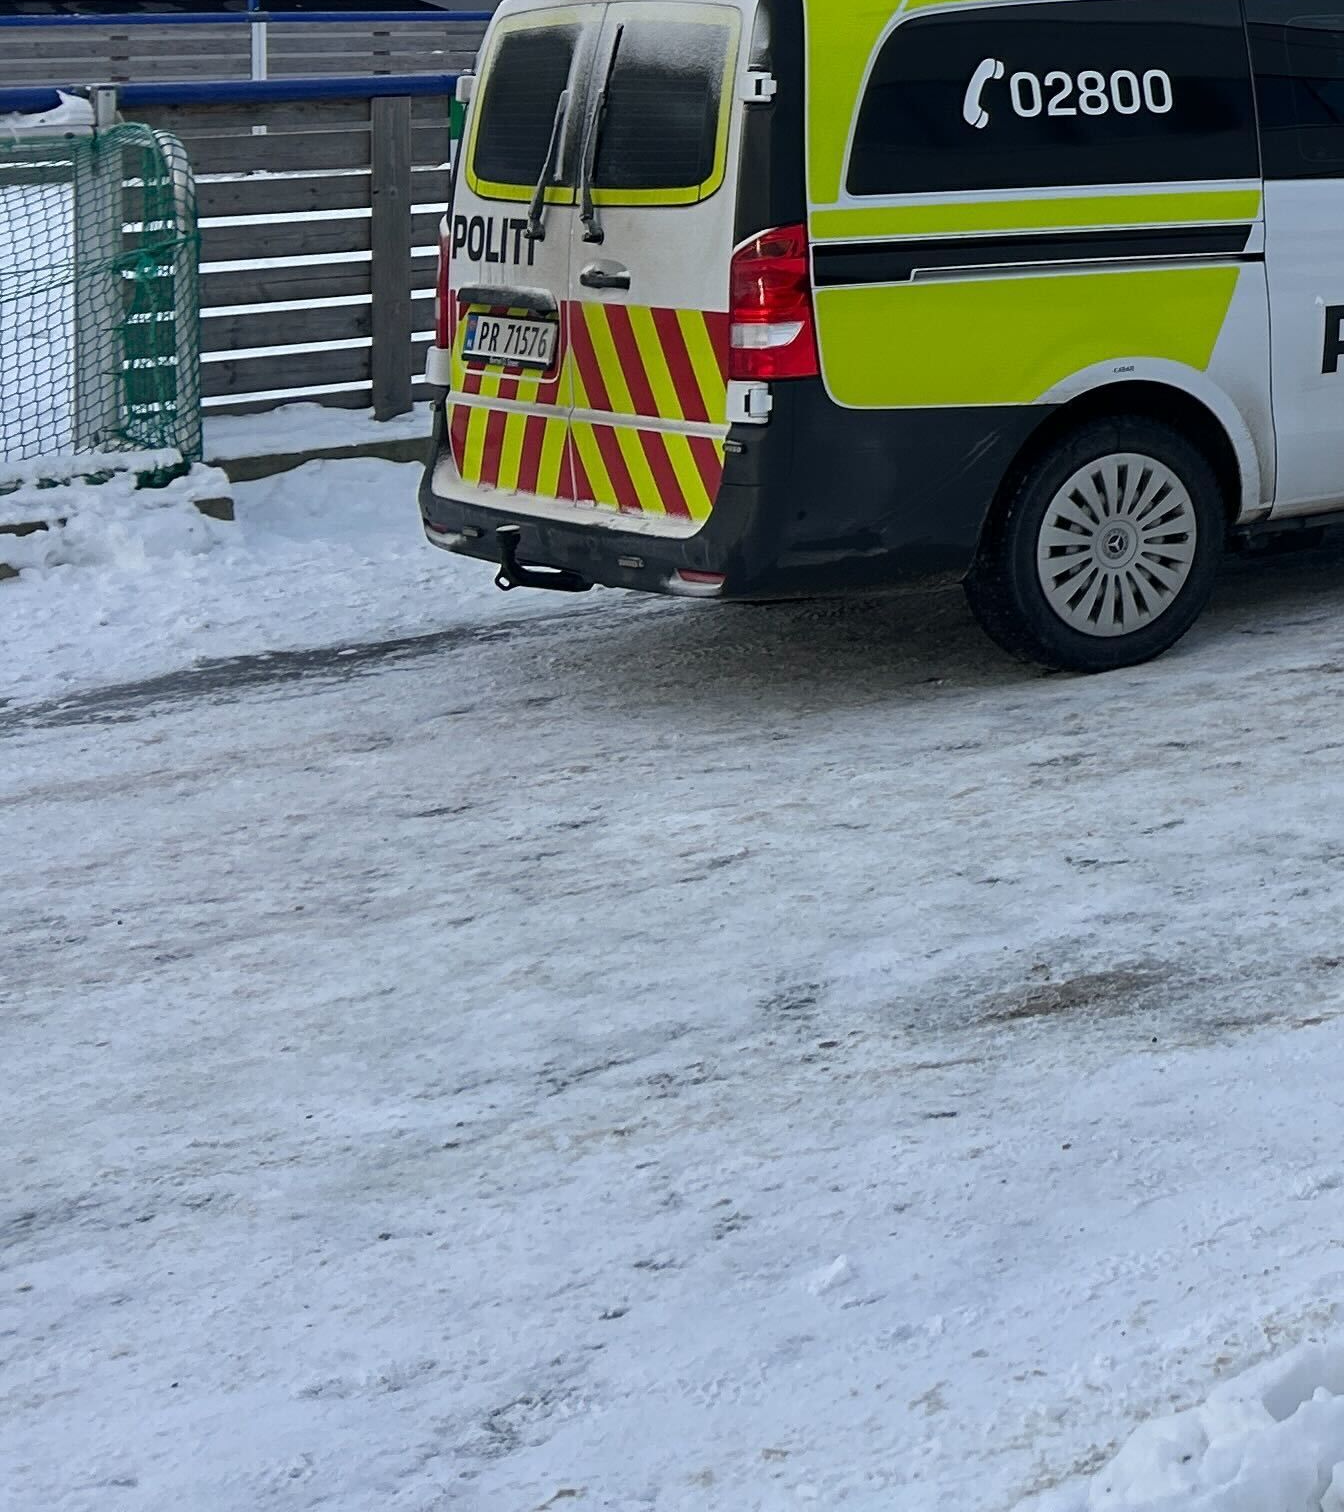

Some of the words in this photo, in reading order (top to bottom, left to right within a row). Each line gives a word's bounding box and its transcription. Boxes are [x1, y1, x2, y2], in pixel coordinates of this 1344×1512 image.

[1010, 69, 1173, 118] 02800
[452, 215, 535, 266] POLITI
[478, 321, 500, 352] PR
[503, 324, 549, 358] 71576
